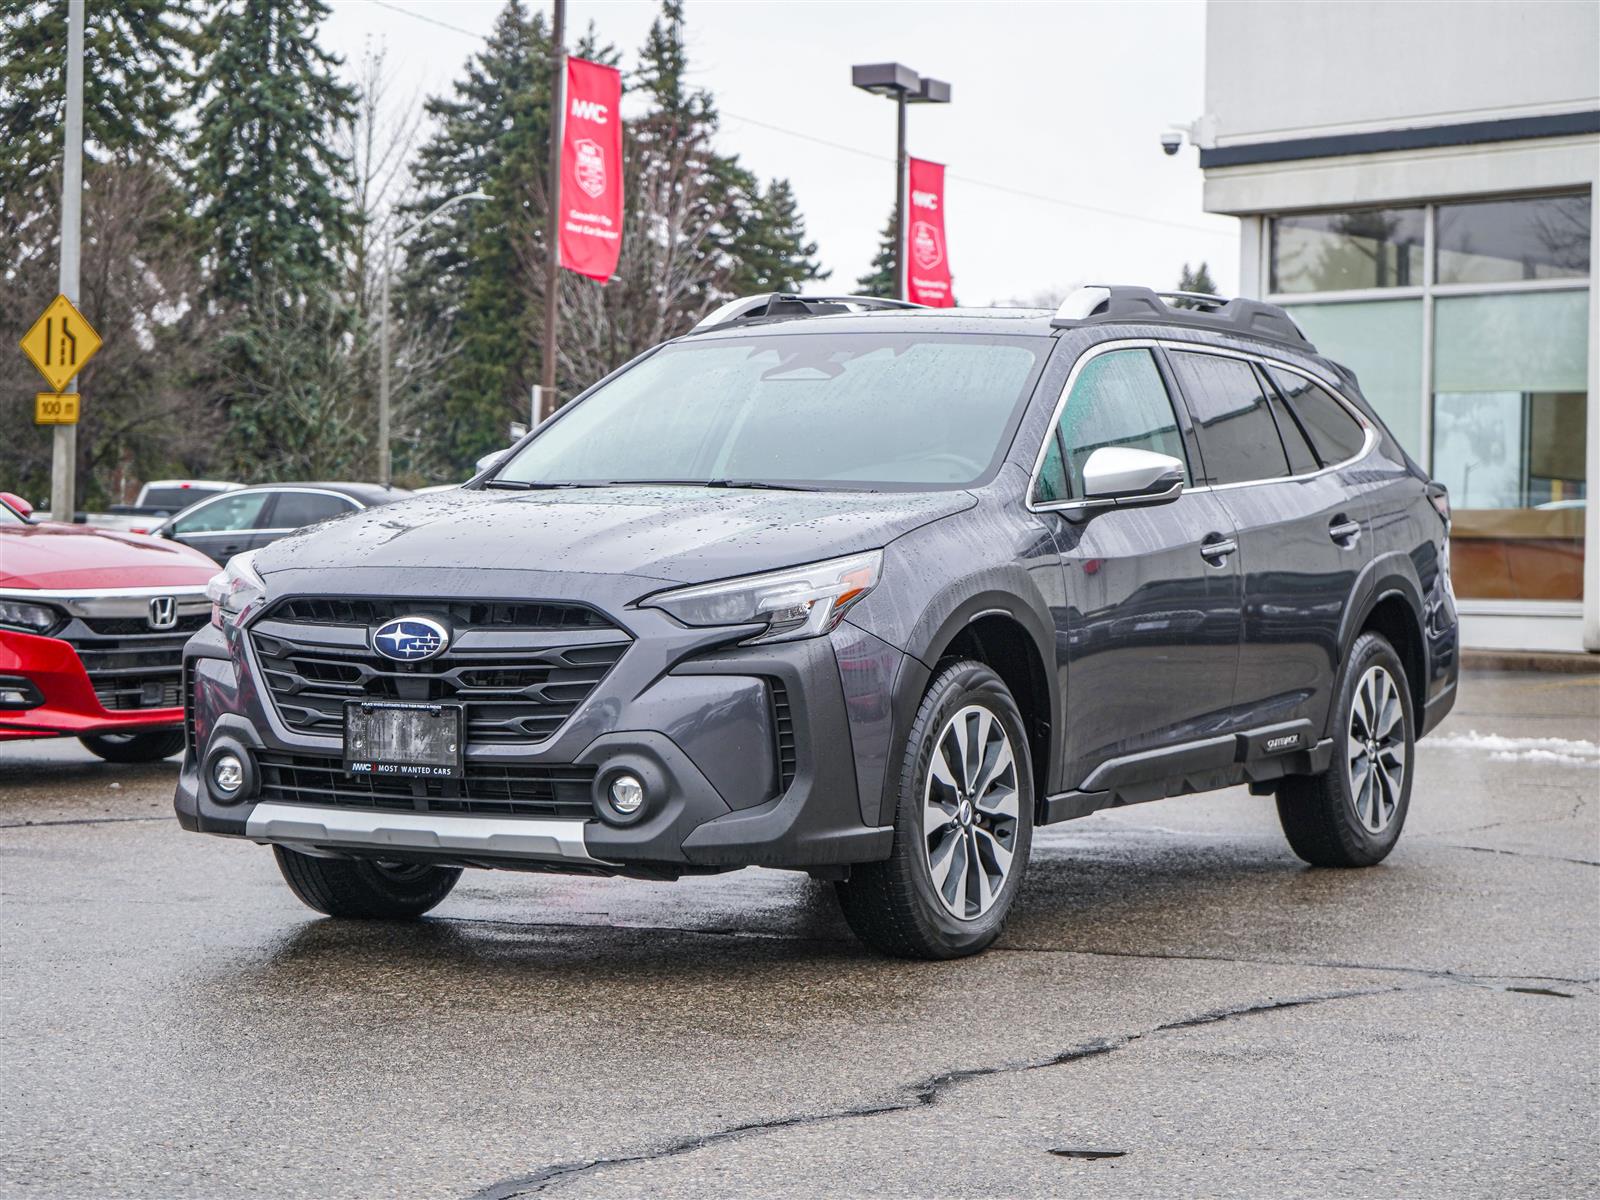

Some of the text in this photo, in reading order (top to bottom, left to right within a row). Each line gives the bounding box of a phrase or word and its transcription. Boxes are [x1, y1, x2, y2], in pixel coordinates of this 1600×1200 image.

[42, 401, 73, 414] 100 m
[401, 766, 431, 774] WANTED
